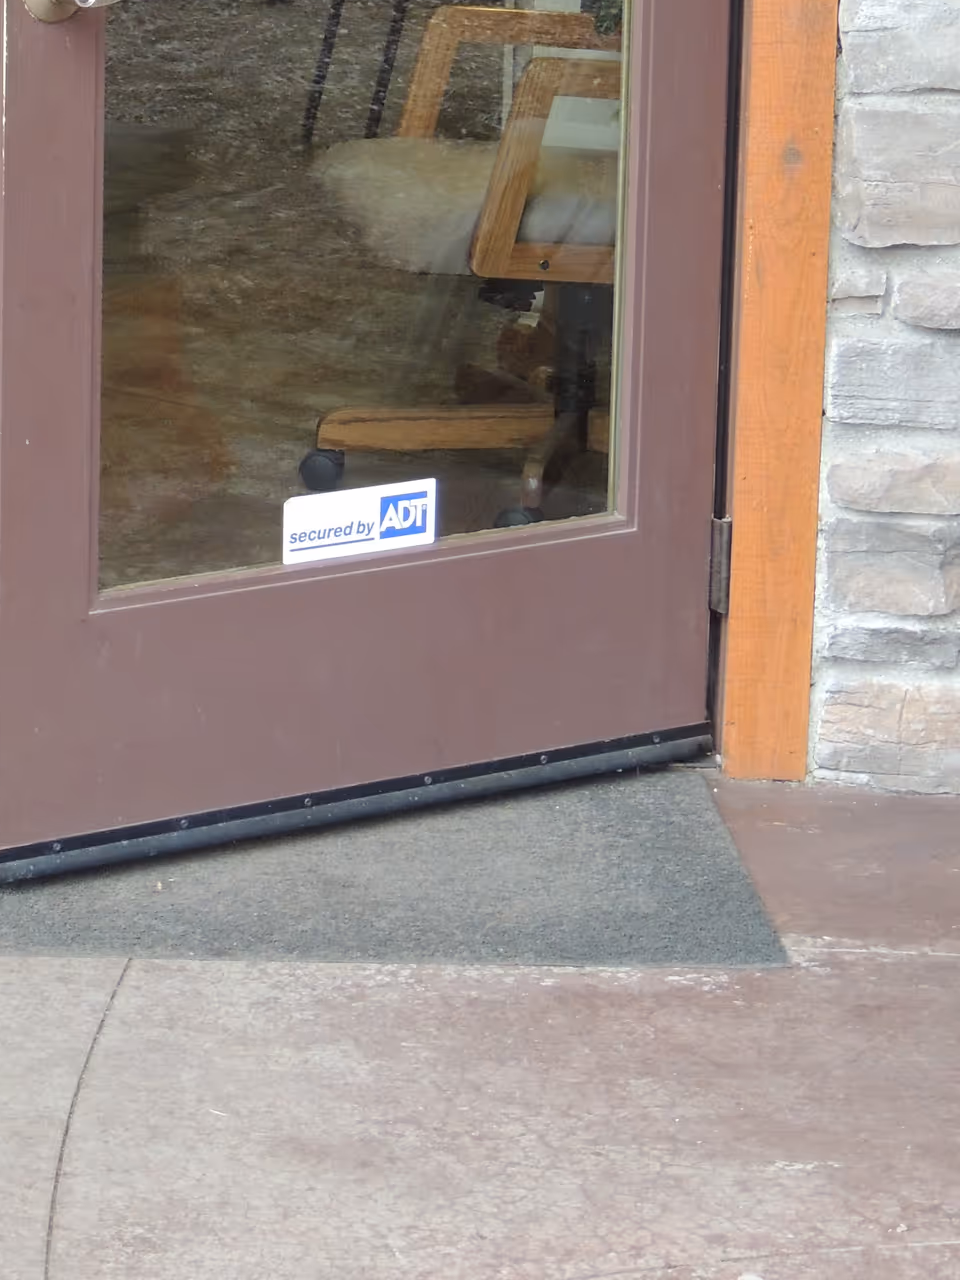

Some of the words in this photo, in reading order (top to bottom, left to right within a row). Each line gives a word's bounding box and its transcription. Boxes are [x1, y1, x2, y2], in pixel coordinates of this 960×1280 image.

[380, 497, 427, 532] ADT
[289, 522, 354, 544] secured
[356, 521, 375, 536] by
